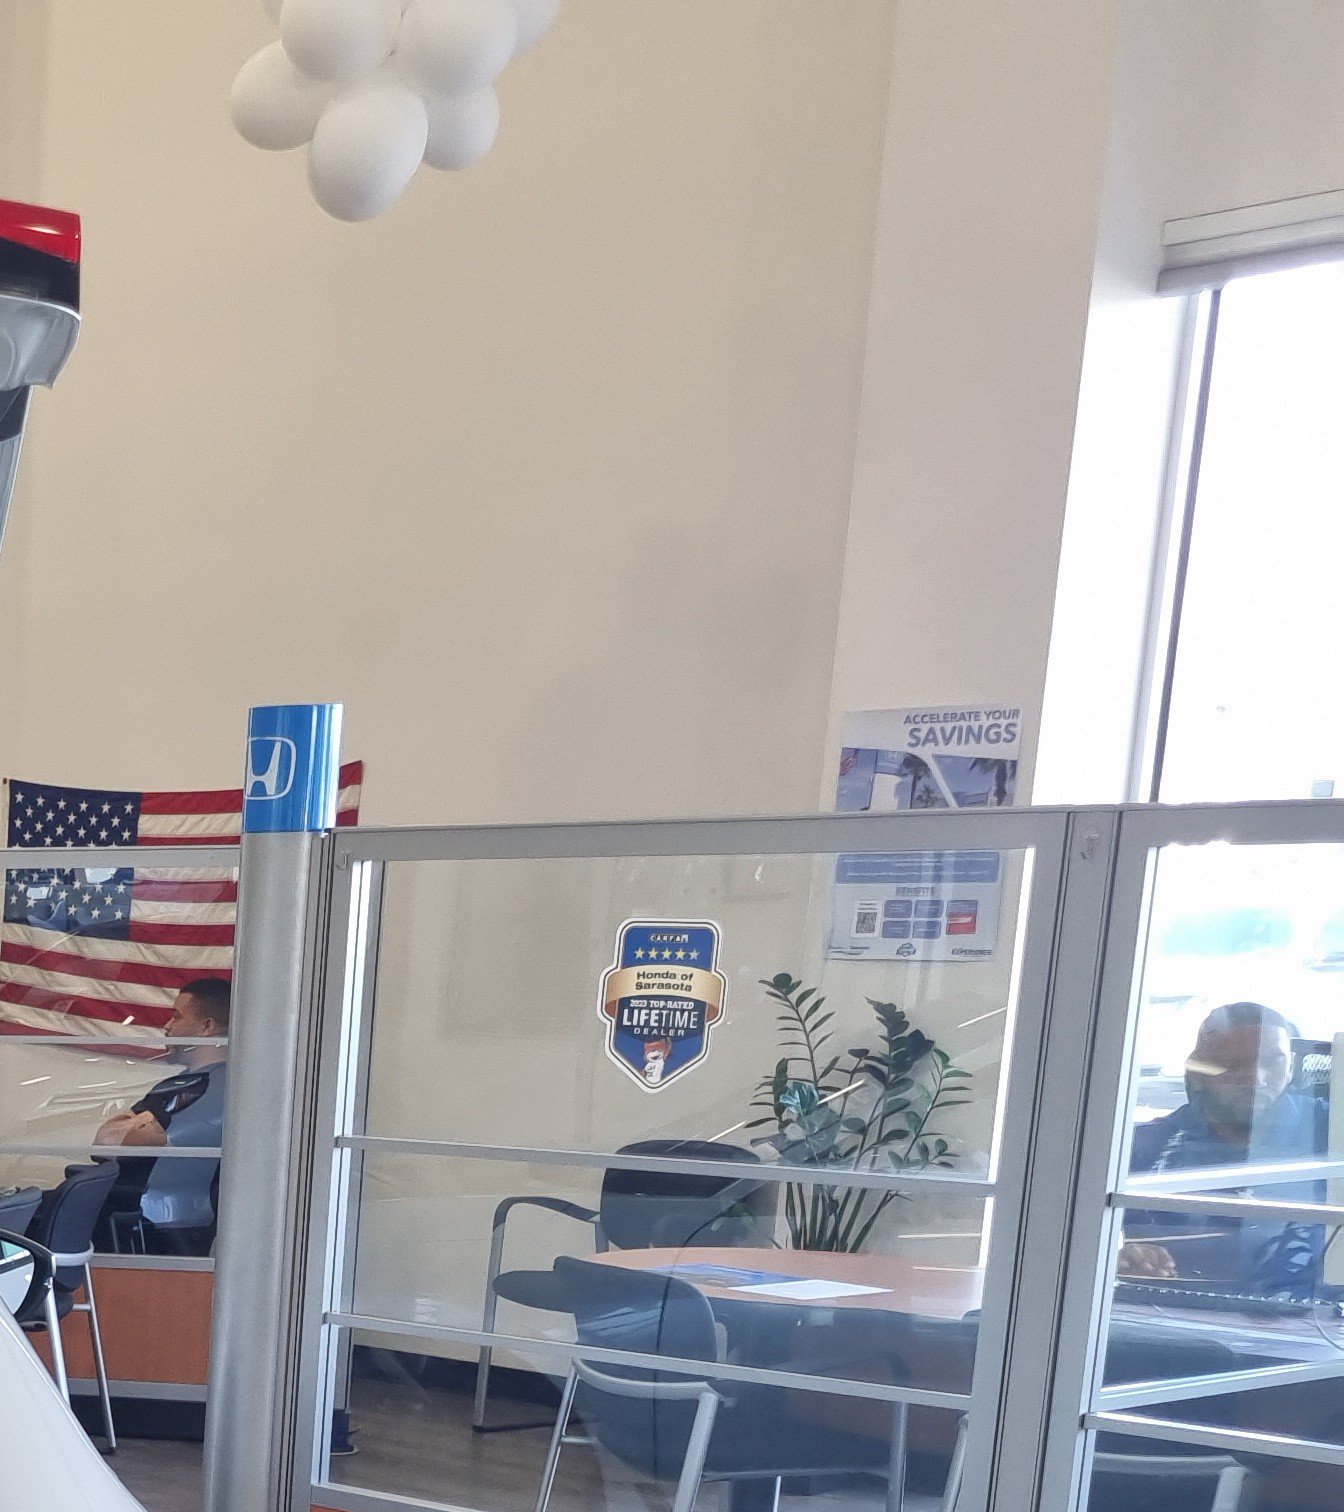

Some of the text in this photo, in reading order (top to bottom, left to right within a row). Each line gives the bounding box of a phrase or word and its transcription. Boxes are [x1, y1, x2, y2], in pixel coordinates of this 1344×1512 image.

[903, 708, 1021, 725] ACCELERATE YOUR
[908, 722, 1018, 748] SAVINGS
[636, 971, 693, 982] Honda of
[635, 981, 692, 992] Sarasota
[622, 1008, 699, 1029] LIFETIME
[633, 1027, 685, 1036] DEALER
